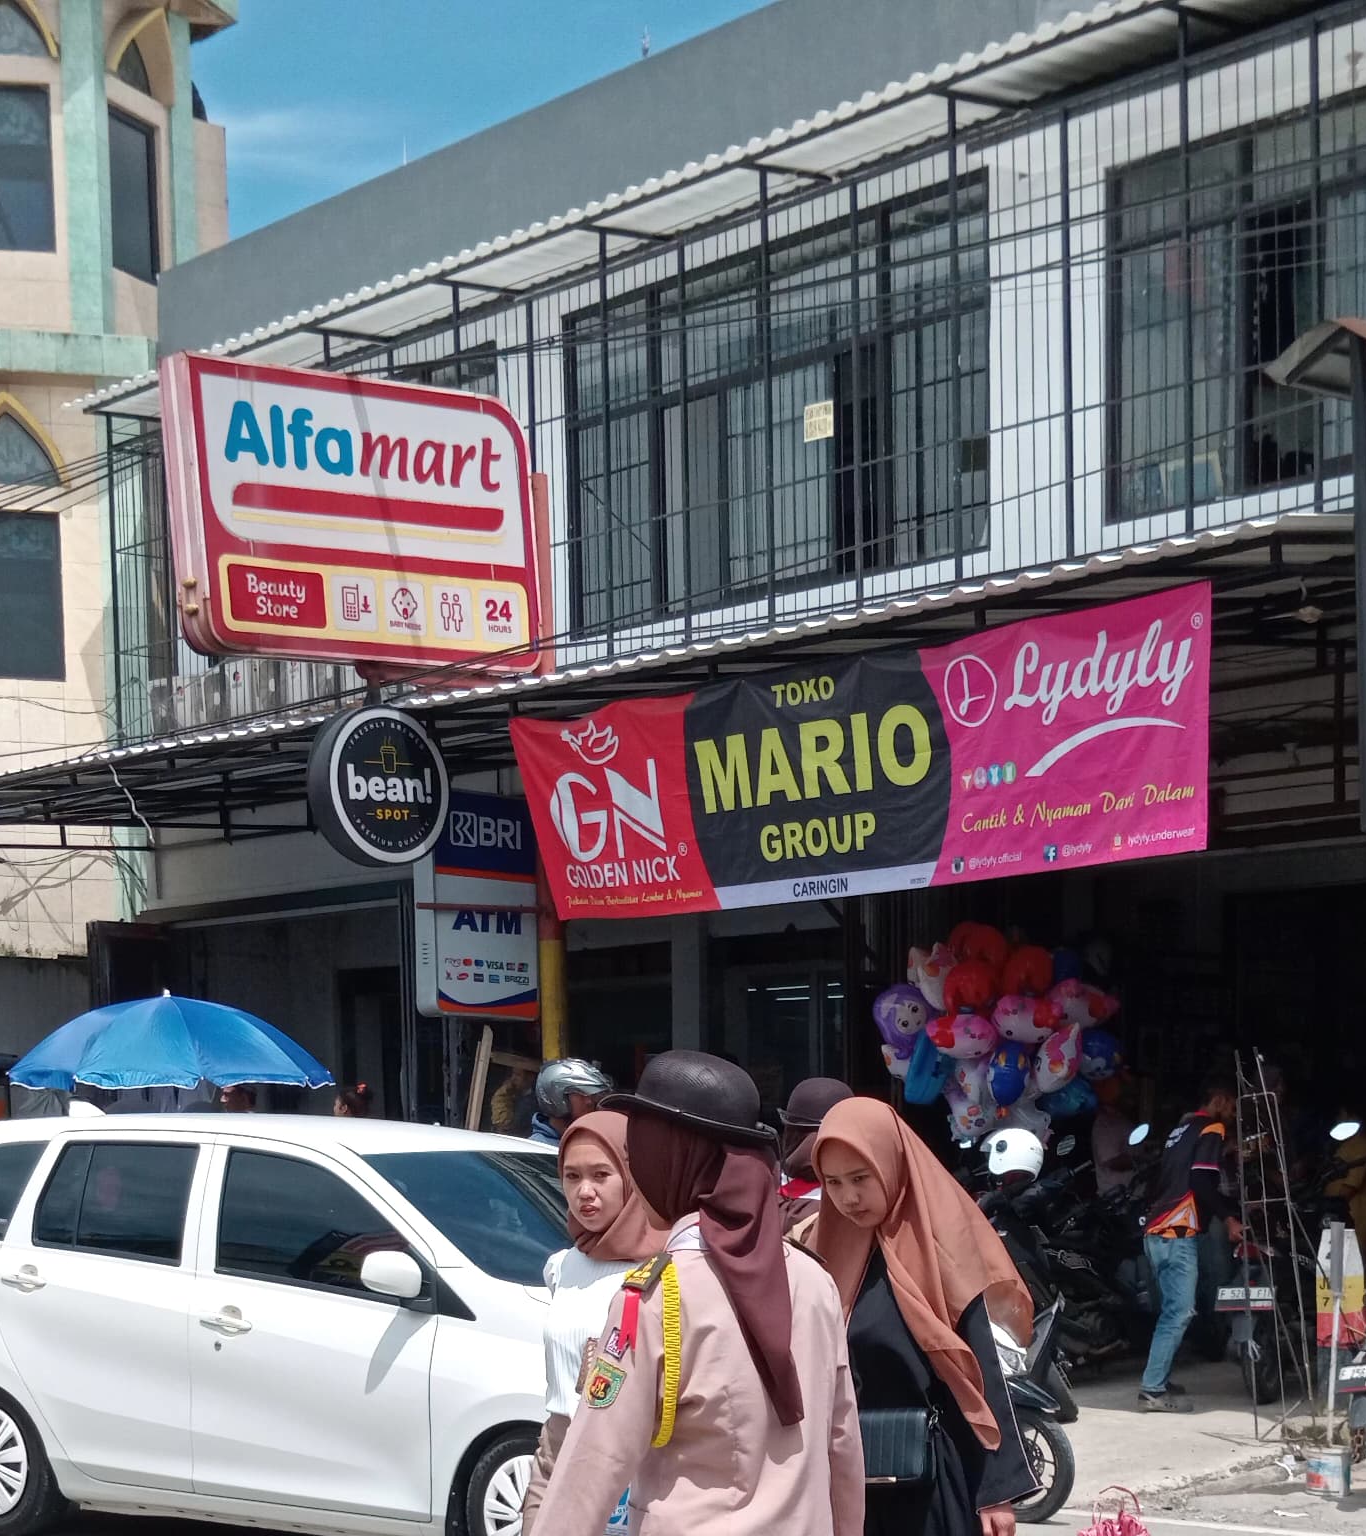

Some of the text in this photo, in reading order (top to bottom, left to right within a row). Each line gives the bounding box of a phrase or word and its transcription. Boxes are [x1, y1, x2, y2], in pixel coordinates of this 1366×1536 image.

[224, 400, 502, 493] Alfamart
[246, 573, 306, 603] Beauty
[256, 597, 299, 620] Store
[485, 600, 513, 622] 24
[488, 623, 513, 635] HOURS
[1004, 618, 1193, 727] Lydyly
[772, 676, 835, 709] TOKO
[694, 704, 932, 814] MARIO
[346, 763, 432, 804] bean!
[376, 809, 410, 821] SPOT
[550, 759, 666, 862] GN
[961, 783, 1195, 833] Cantik & Nyaman Dari Dalam
[478, 817, 522, 850] BRI
[760, 812, 876, 864] GROUP
[566, 855, 681, 889] GOLDEN NICK
[793, 878, 848, 897] CARINGIN
[452, 911, 522, 935] ATM
[485, 960, 504, 971] VISA
